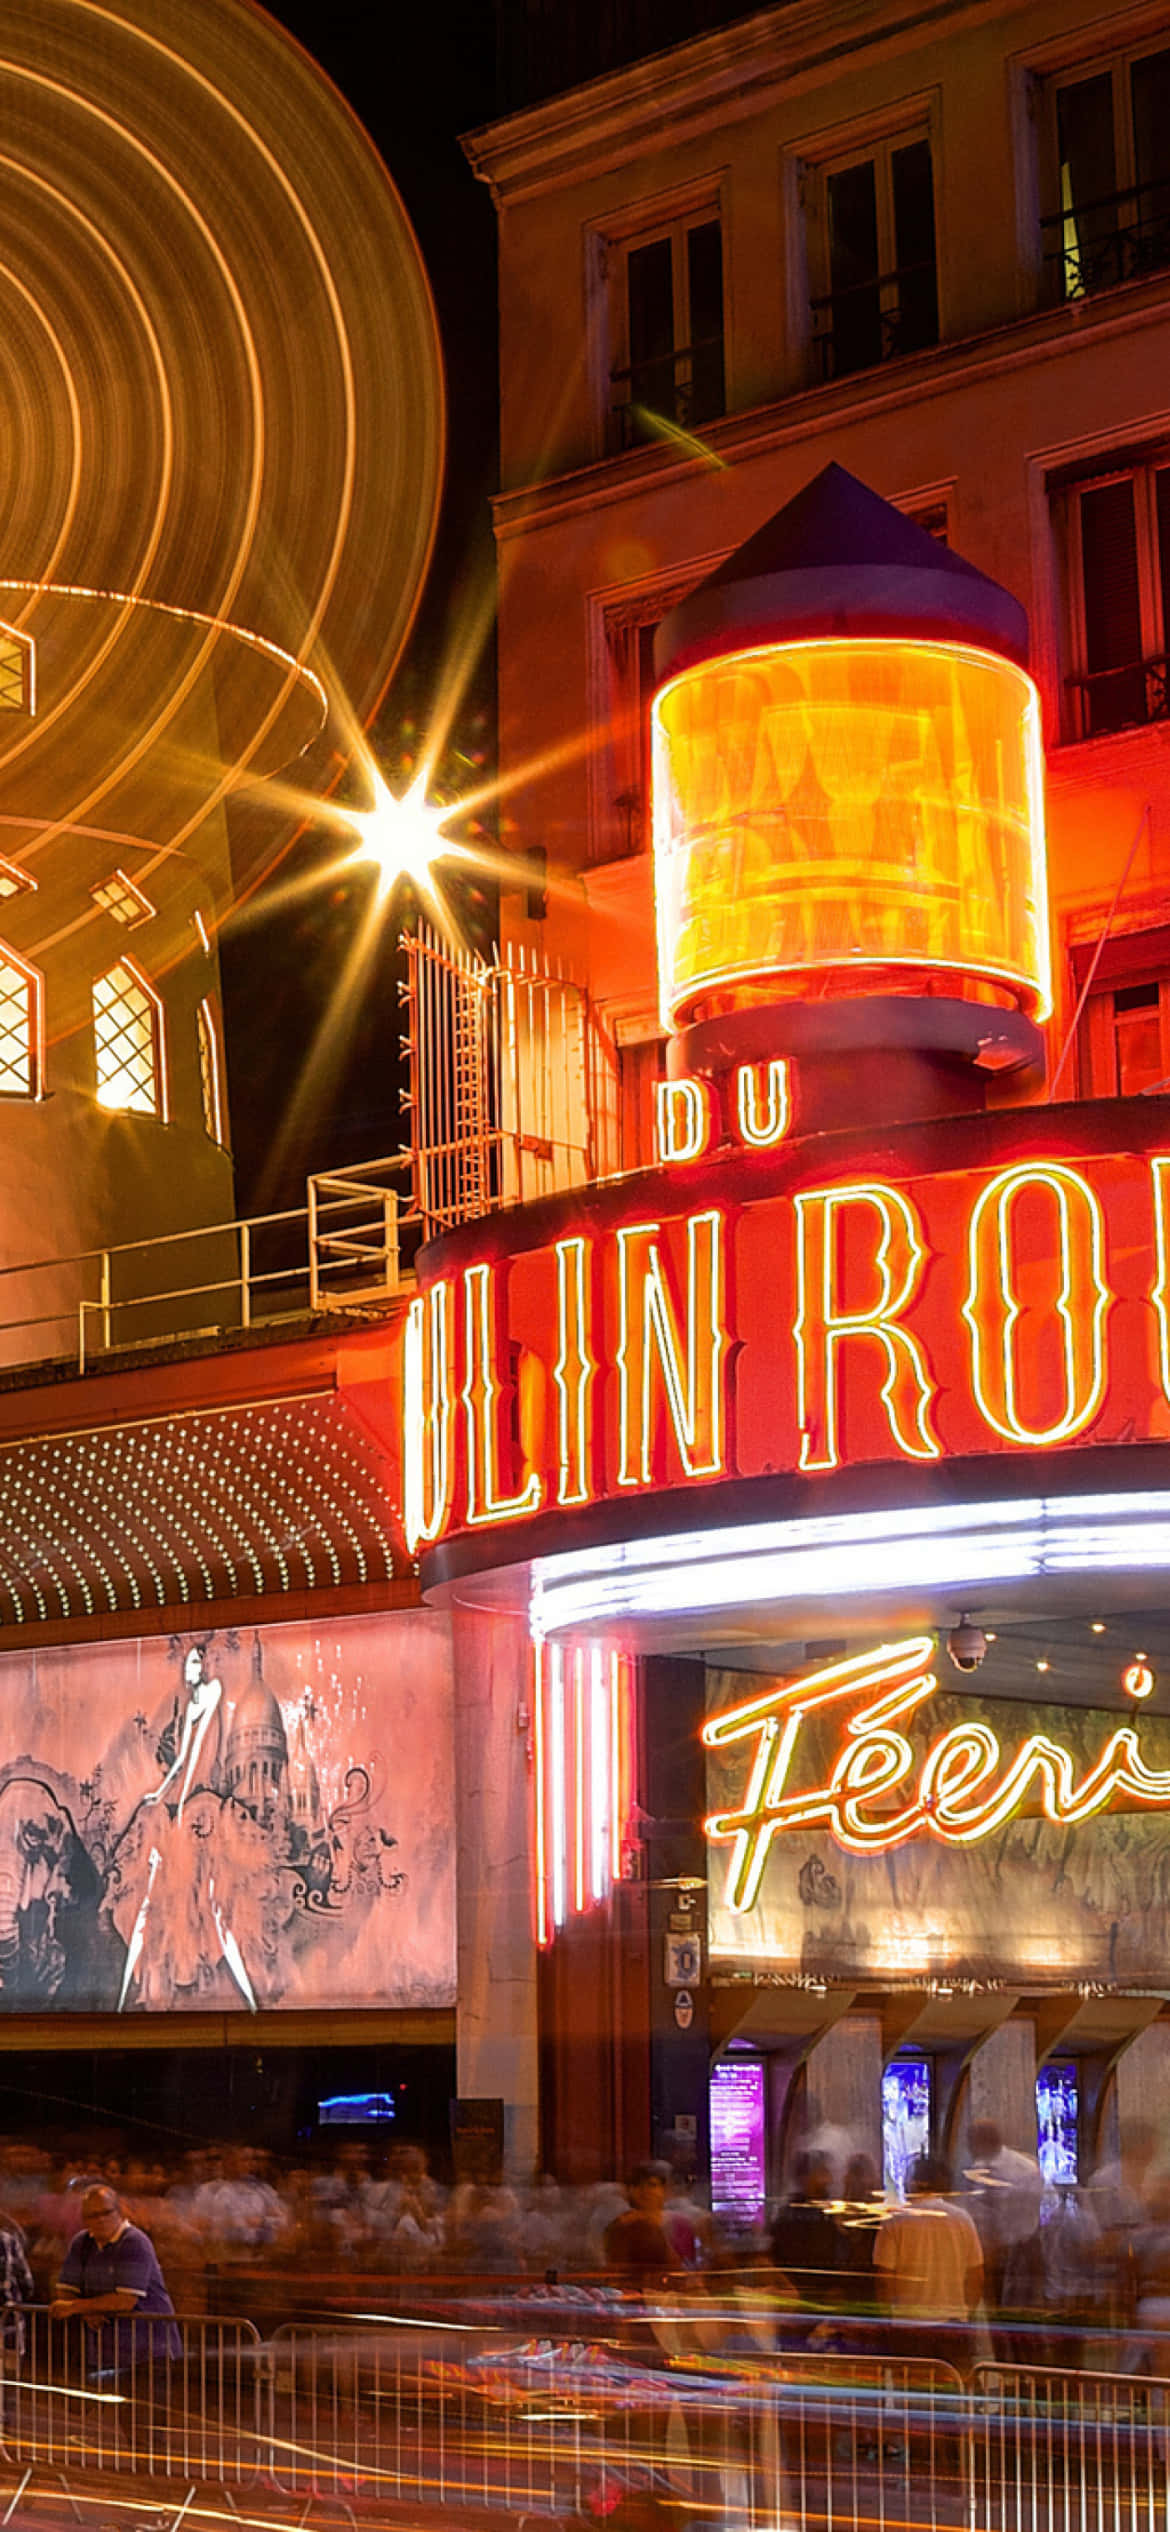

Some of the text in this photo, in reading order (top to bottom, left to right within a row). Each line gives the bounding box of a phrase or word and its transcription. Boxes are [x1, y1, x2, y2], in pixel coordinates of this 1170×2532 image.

[656, 1058, 788, 1163] DU
[403, 1158, 1170, 1553] ULIN RO
